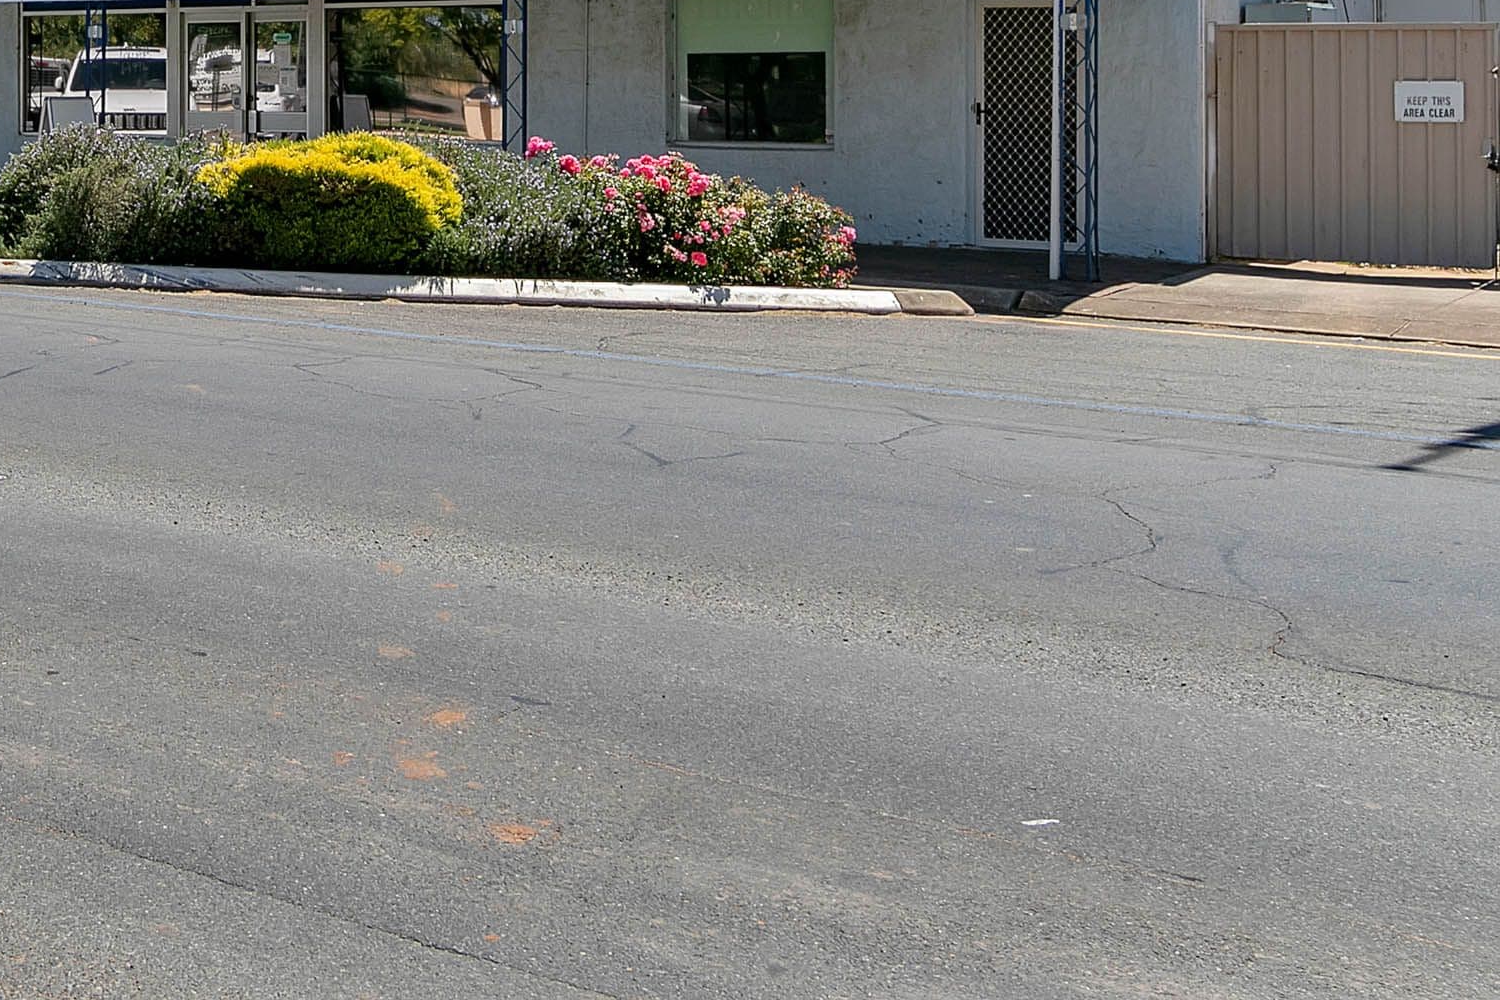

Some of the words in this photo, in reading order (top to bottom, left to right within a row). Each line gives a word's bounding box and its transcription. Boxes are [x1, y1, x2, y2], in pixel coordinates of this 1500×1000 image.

[1406, 96, 1428, 106] KEEP
[1432, 96, 1452, 106] THIS
[1403, 108, 1426, 118] AREA
[1428, 108, 1455, 118] CLEAR
